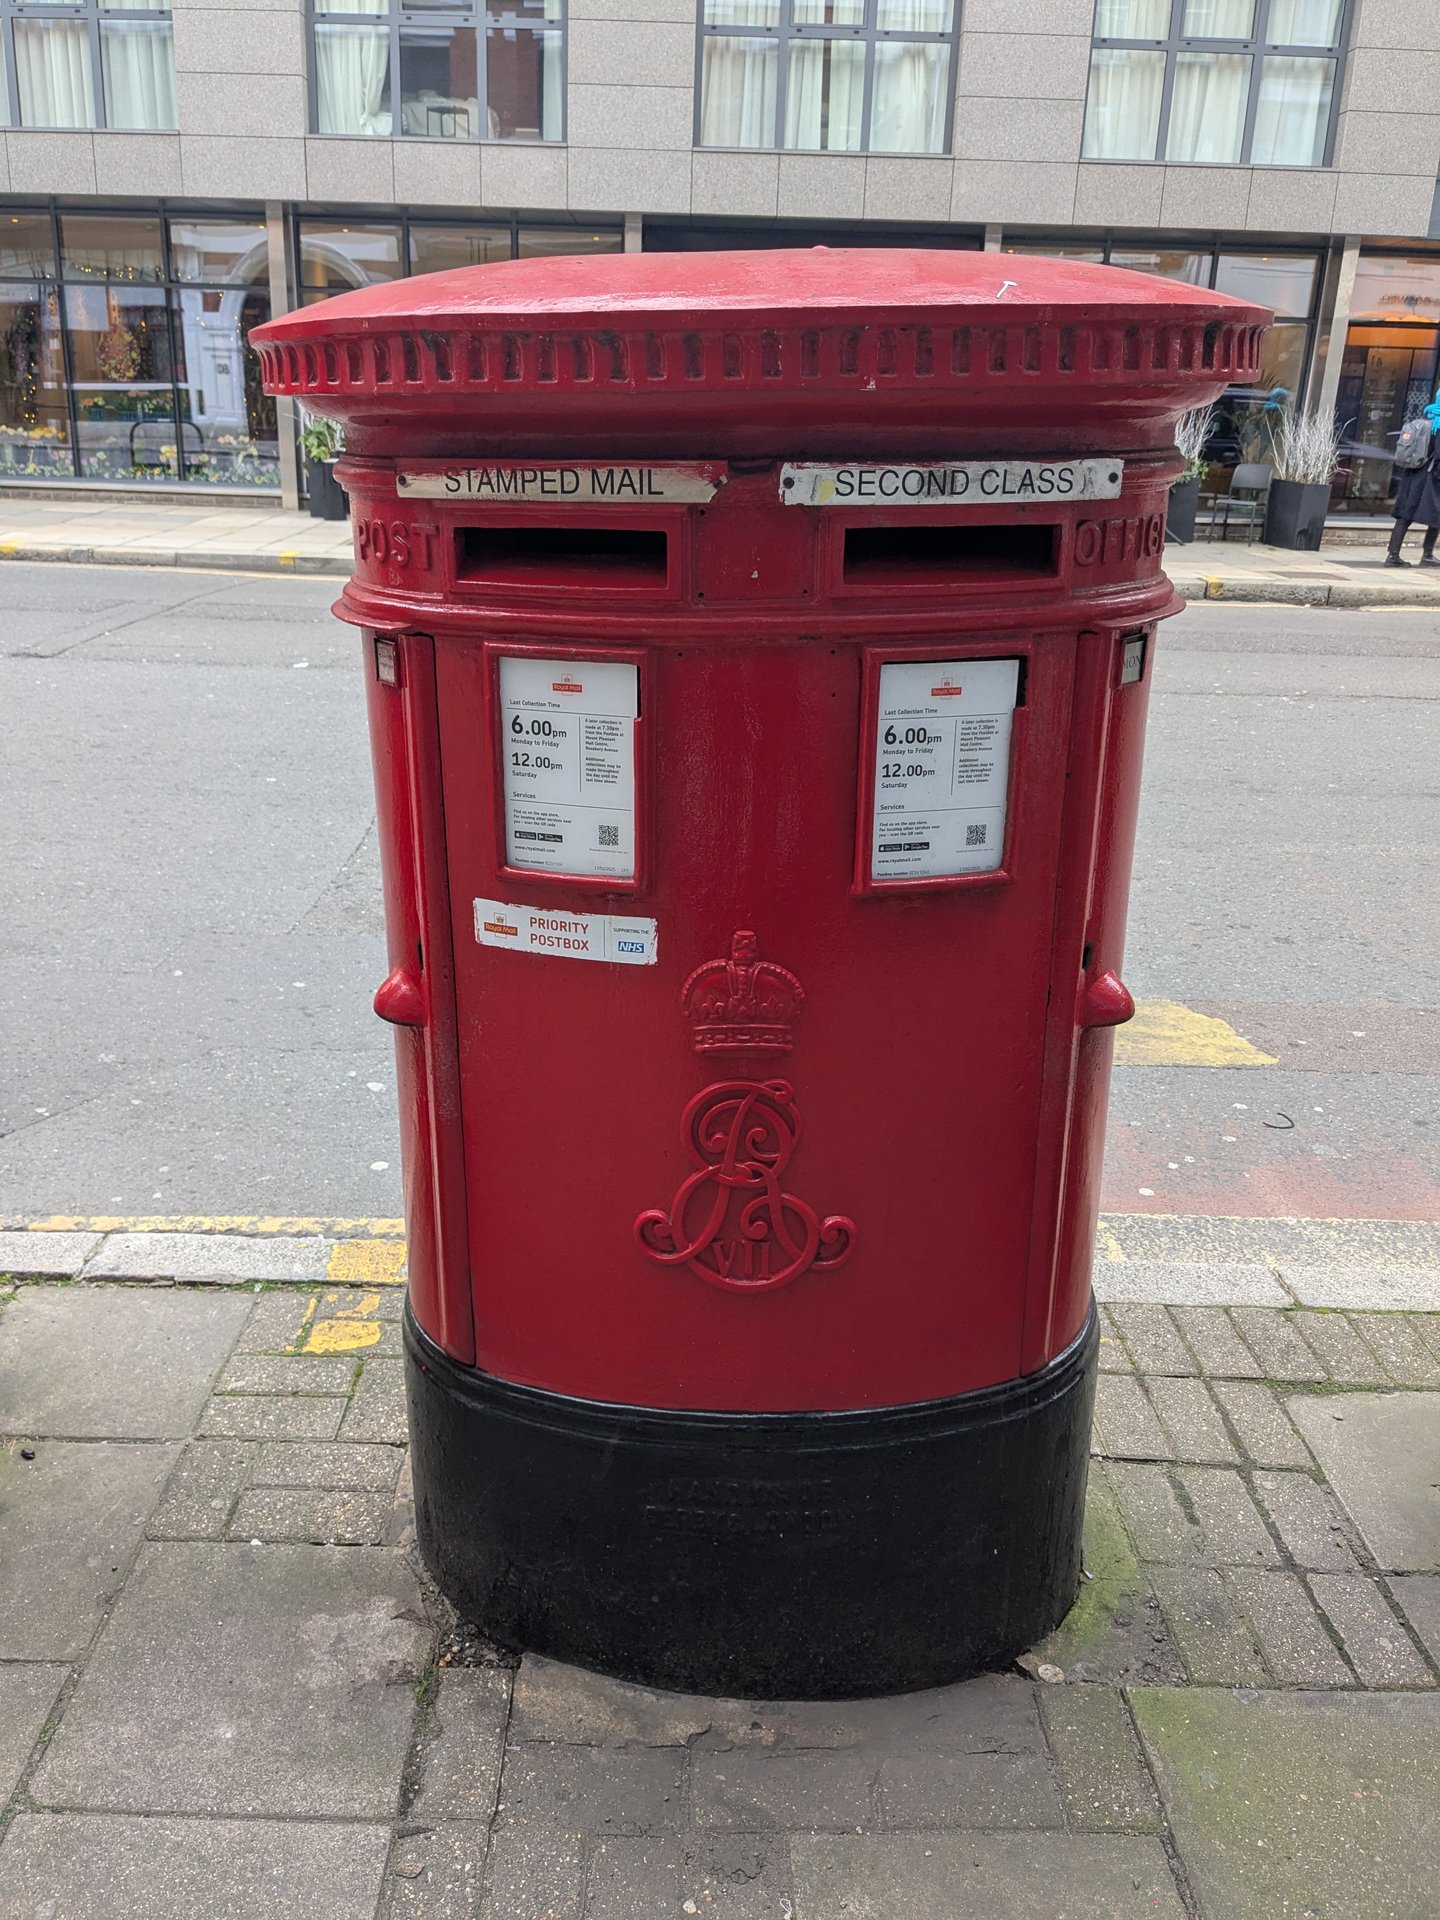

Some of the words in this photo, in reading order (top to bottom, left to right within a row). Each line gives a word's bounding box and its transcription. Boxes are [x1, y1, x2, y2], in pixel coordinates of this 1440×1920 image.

[445, 468, 580, 495] STAMPED
[592, 468, 664, 496] MAIL
[835, 468, 969, 497] SECOND
[980, 468, 1074, 496] CLASS
[359, 519, 439, 570] POST
[1075, 514, 1164, 566] OFFIC
[511, 714, 567, 738] 6.00pm
[884, 724, 942, 745] 6.00pm
[511, 738, 532, 746] Monday
[512, 752, 562, 770] 12.00pm
[512, 770, 537, 779] Saturday
[882, 763, 935, 778] 12.00pm
[513, 792, 536, 800] Services
[485, 924, 502, 933] Royal
[503, 926, 517, 934] Mail
[529, 916, 589, 934] PRIORITY
[530, 934, 589, 951] POSTBOX
[618, 942, 643, 952] NHS
[711, 1240, 773, 1278] VII
